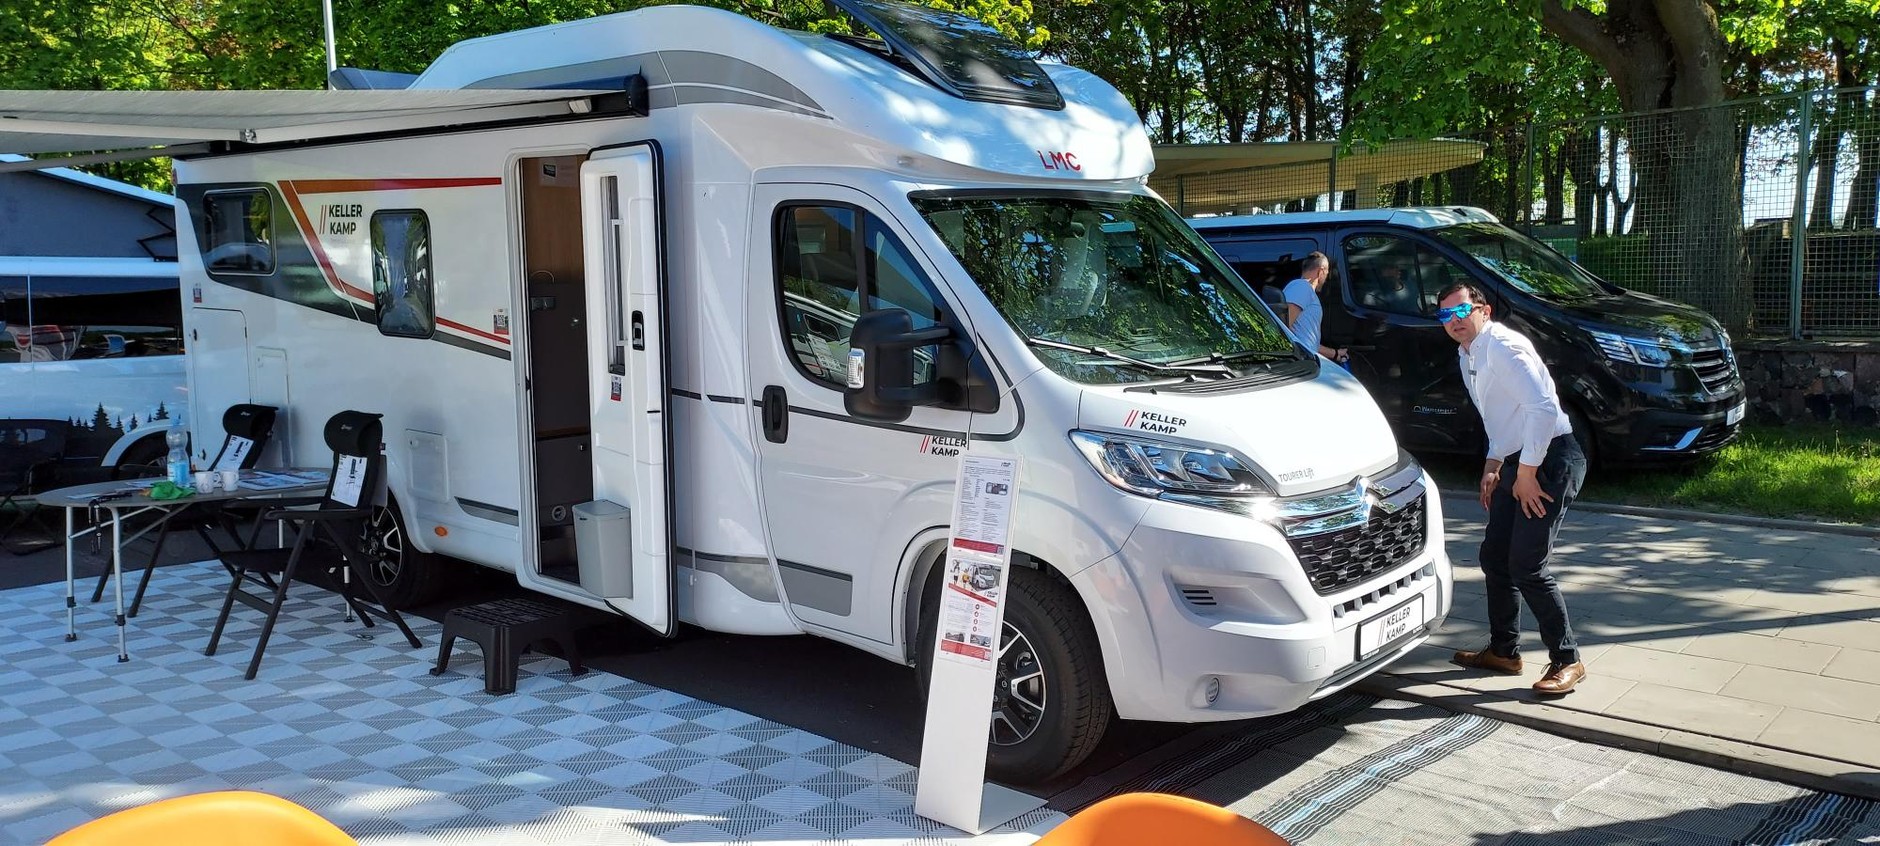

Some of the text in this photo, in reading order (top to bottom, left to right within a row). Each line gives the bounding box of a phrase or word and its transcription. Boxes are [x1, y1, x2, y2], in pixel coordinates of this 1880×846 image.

[1037, 150, 1081, 171] LMC
[329, 204, 363, 218] KELLER
[330, 221, 357, 235] KAMP
[1141, 411, 1187, 427] KELLER
[1140, 421, 1177, 434] KAMP
[931, 435, 967, 448] KELLER
[931, 446, 960, 457] KAMP
[1278, 470, 1304, 482] TOURER
[1386, 606, 1411, 628] KELLER
[1386, 622, 1406, 642] KAMP
